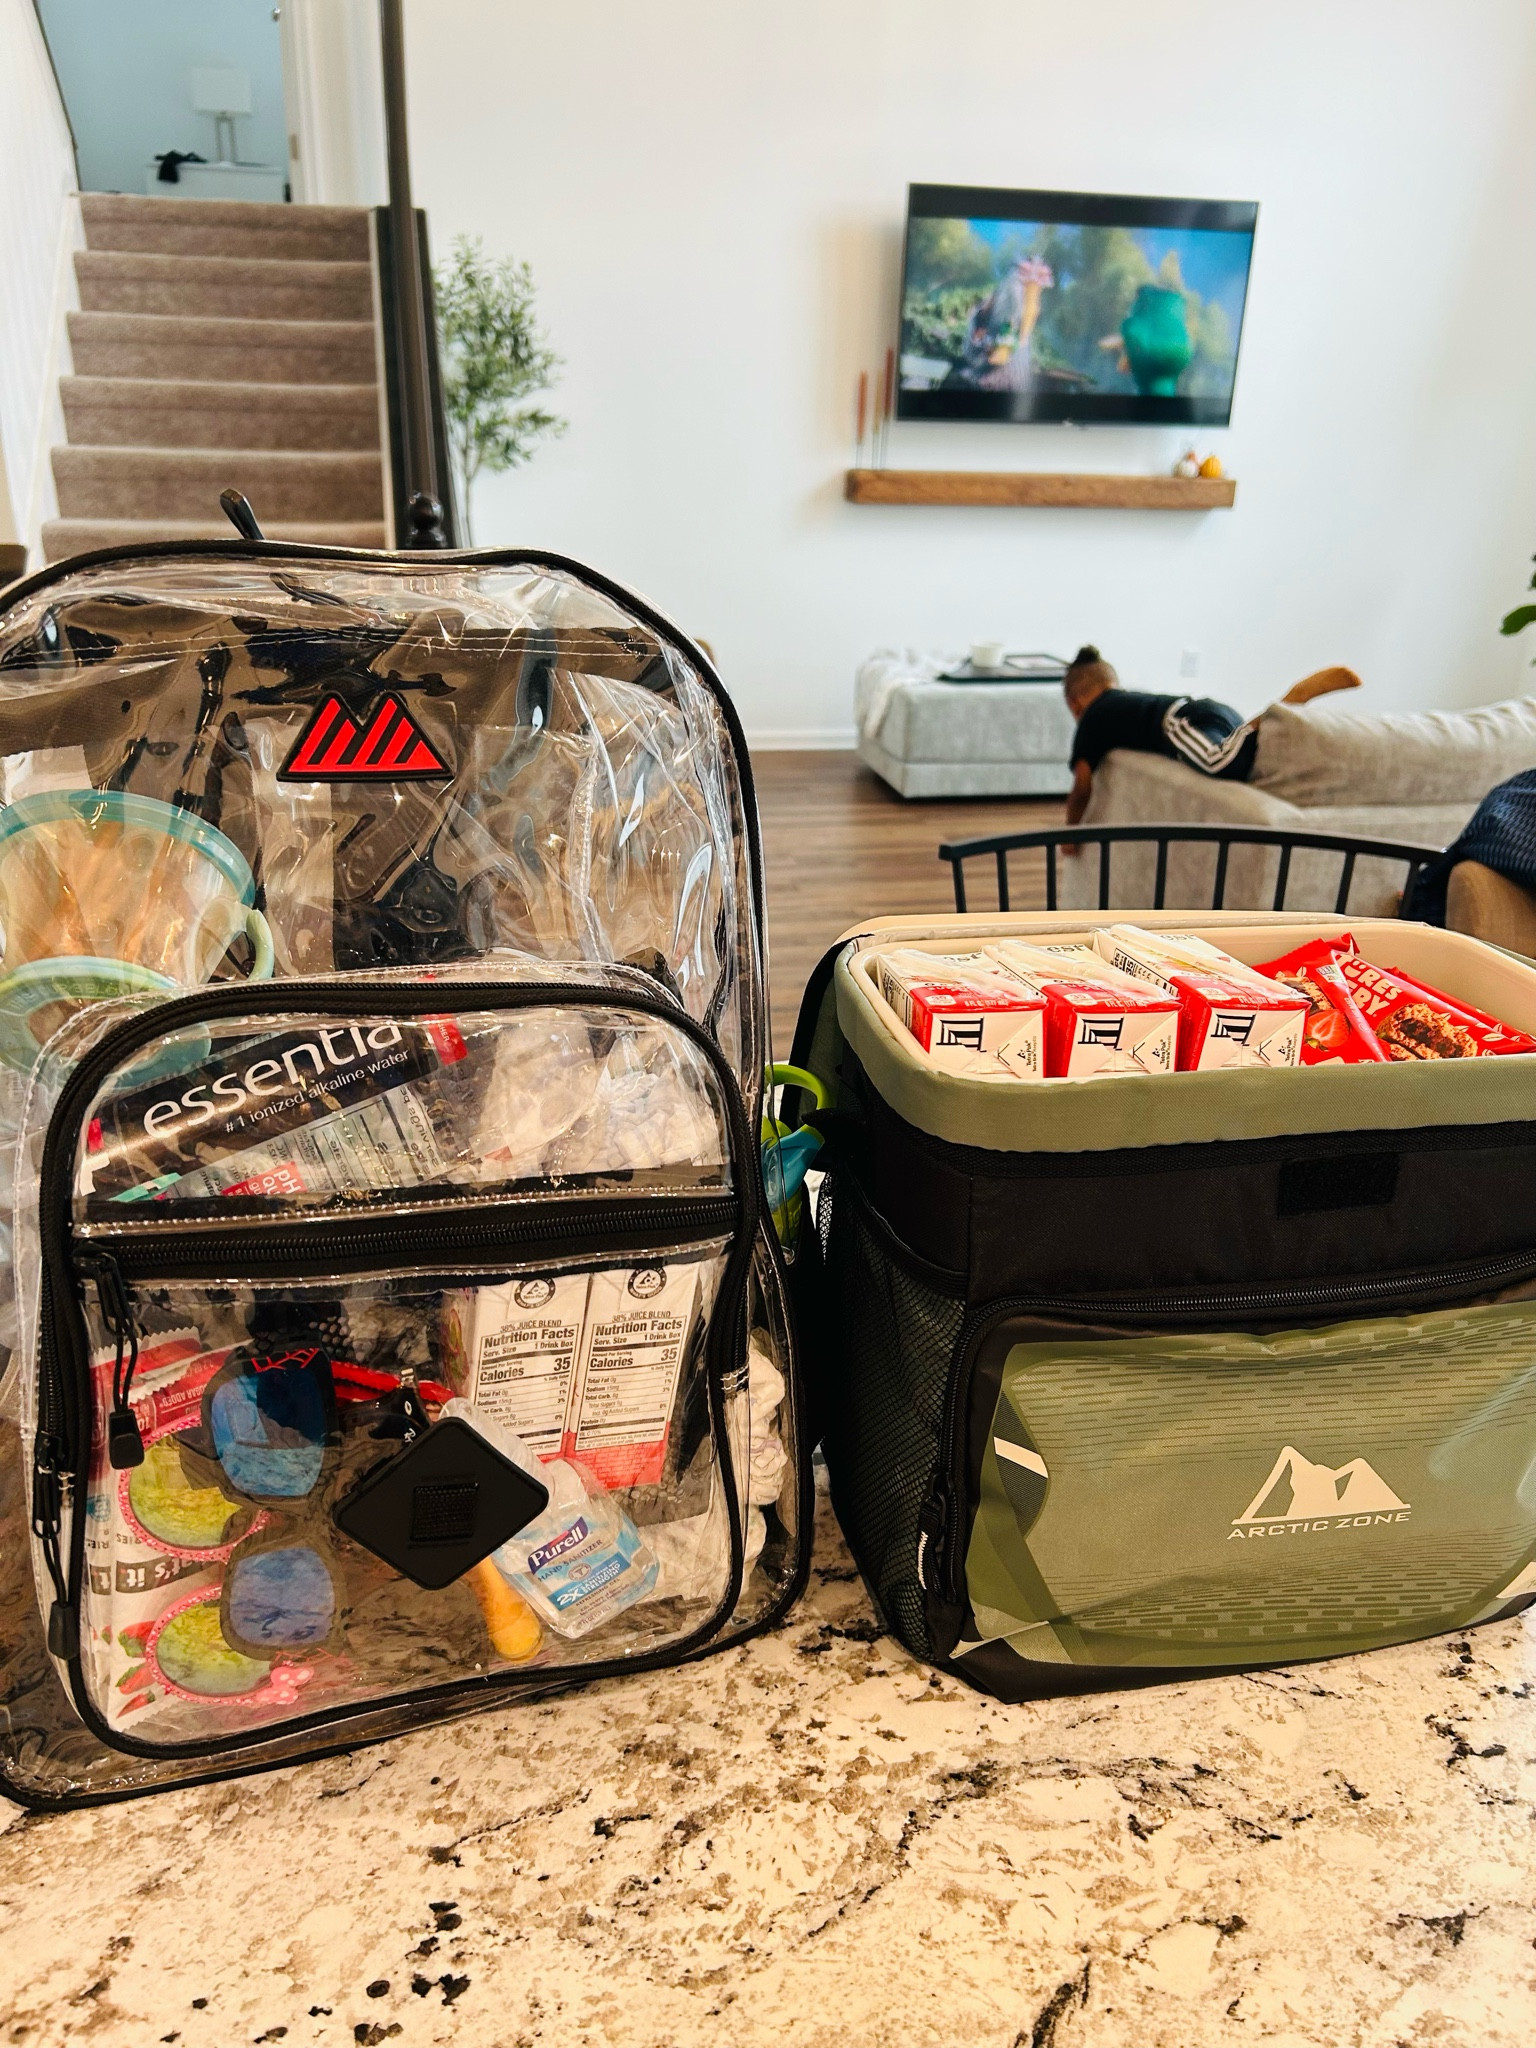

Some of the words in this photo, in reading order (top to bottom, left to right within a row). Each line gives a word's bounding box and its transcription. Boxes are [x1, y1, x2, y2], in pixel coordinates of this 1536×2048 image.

[249, 1091, 304, 1123] ionized
[308, 1069, 366, 1099] alkaline
[367, 1050, 409, 1072] water
[517, 1320, 537, 1330] JUICE
[538, 1320, 562, 1328] BLEND
[628, 1311, 647, 1320] JUICE
[648, 1310, 671, 1318] BLEND
[595, 1321, 648, 1336] Nutrition
[650, 1319, 682, 1331] Facts
[613, 1336, 628, 1344] Size
[649, 1331, 667, 1340] Drink
[483, 1349, 499, 1358] Serv.
[502, 1346, 517, 1354] Size
[540, 1340, 559, 1349] Drink
[484, 1331, 537, 1349] Nutrition
[541, 1328, 575, 1339] Facts
[590, 1357, 634, 1368] Calories
[660, 1347, 678, 1361] 35
[480, 1366, 524, 1382] Calories
[554, 1356, 571, 1371] 35
[1227, 1520, 1329, 1540] ARCTIC
[1335, 1512, 1412, 1529] ZONE
[530, 1526, 584, 1567] Purell
[538, 1565, 563, 1582] HAND
[563, 1539, 603, 1567] SANITIZER
[556, 1588, 585, 1606] 2X
